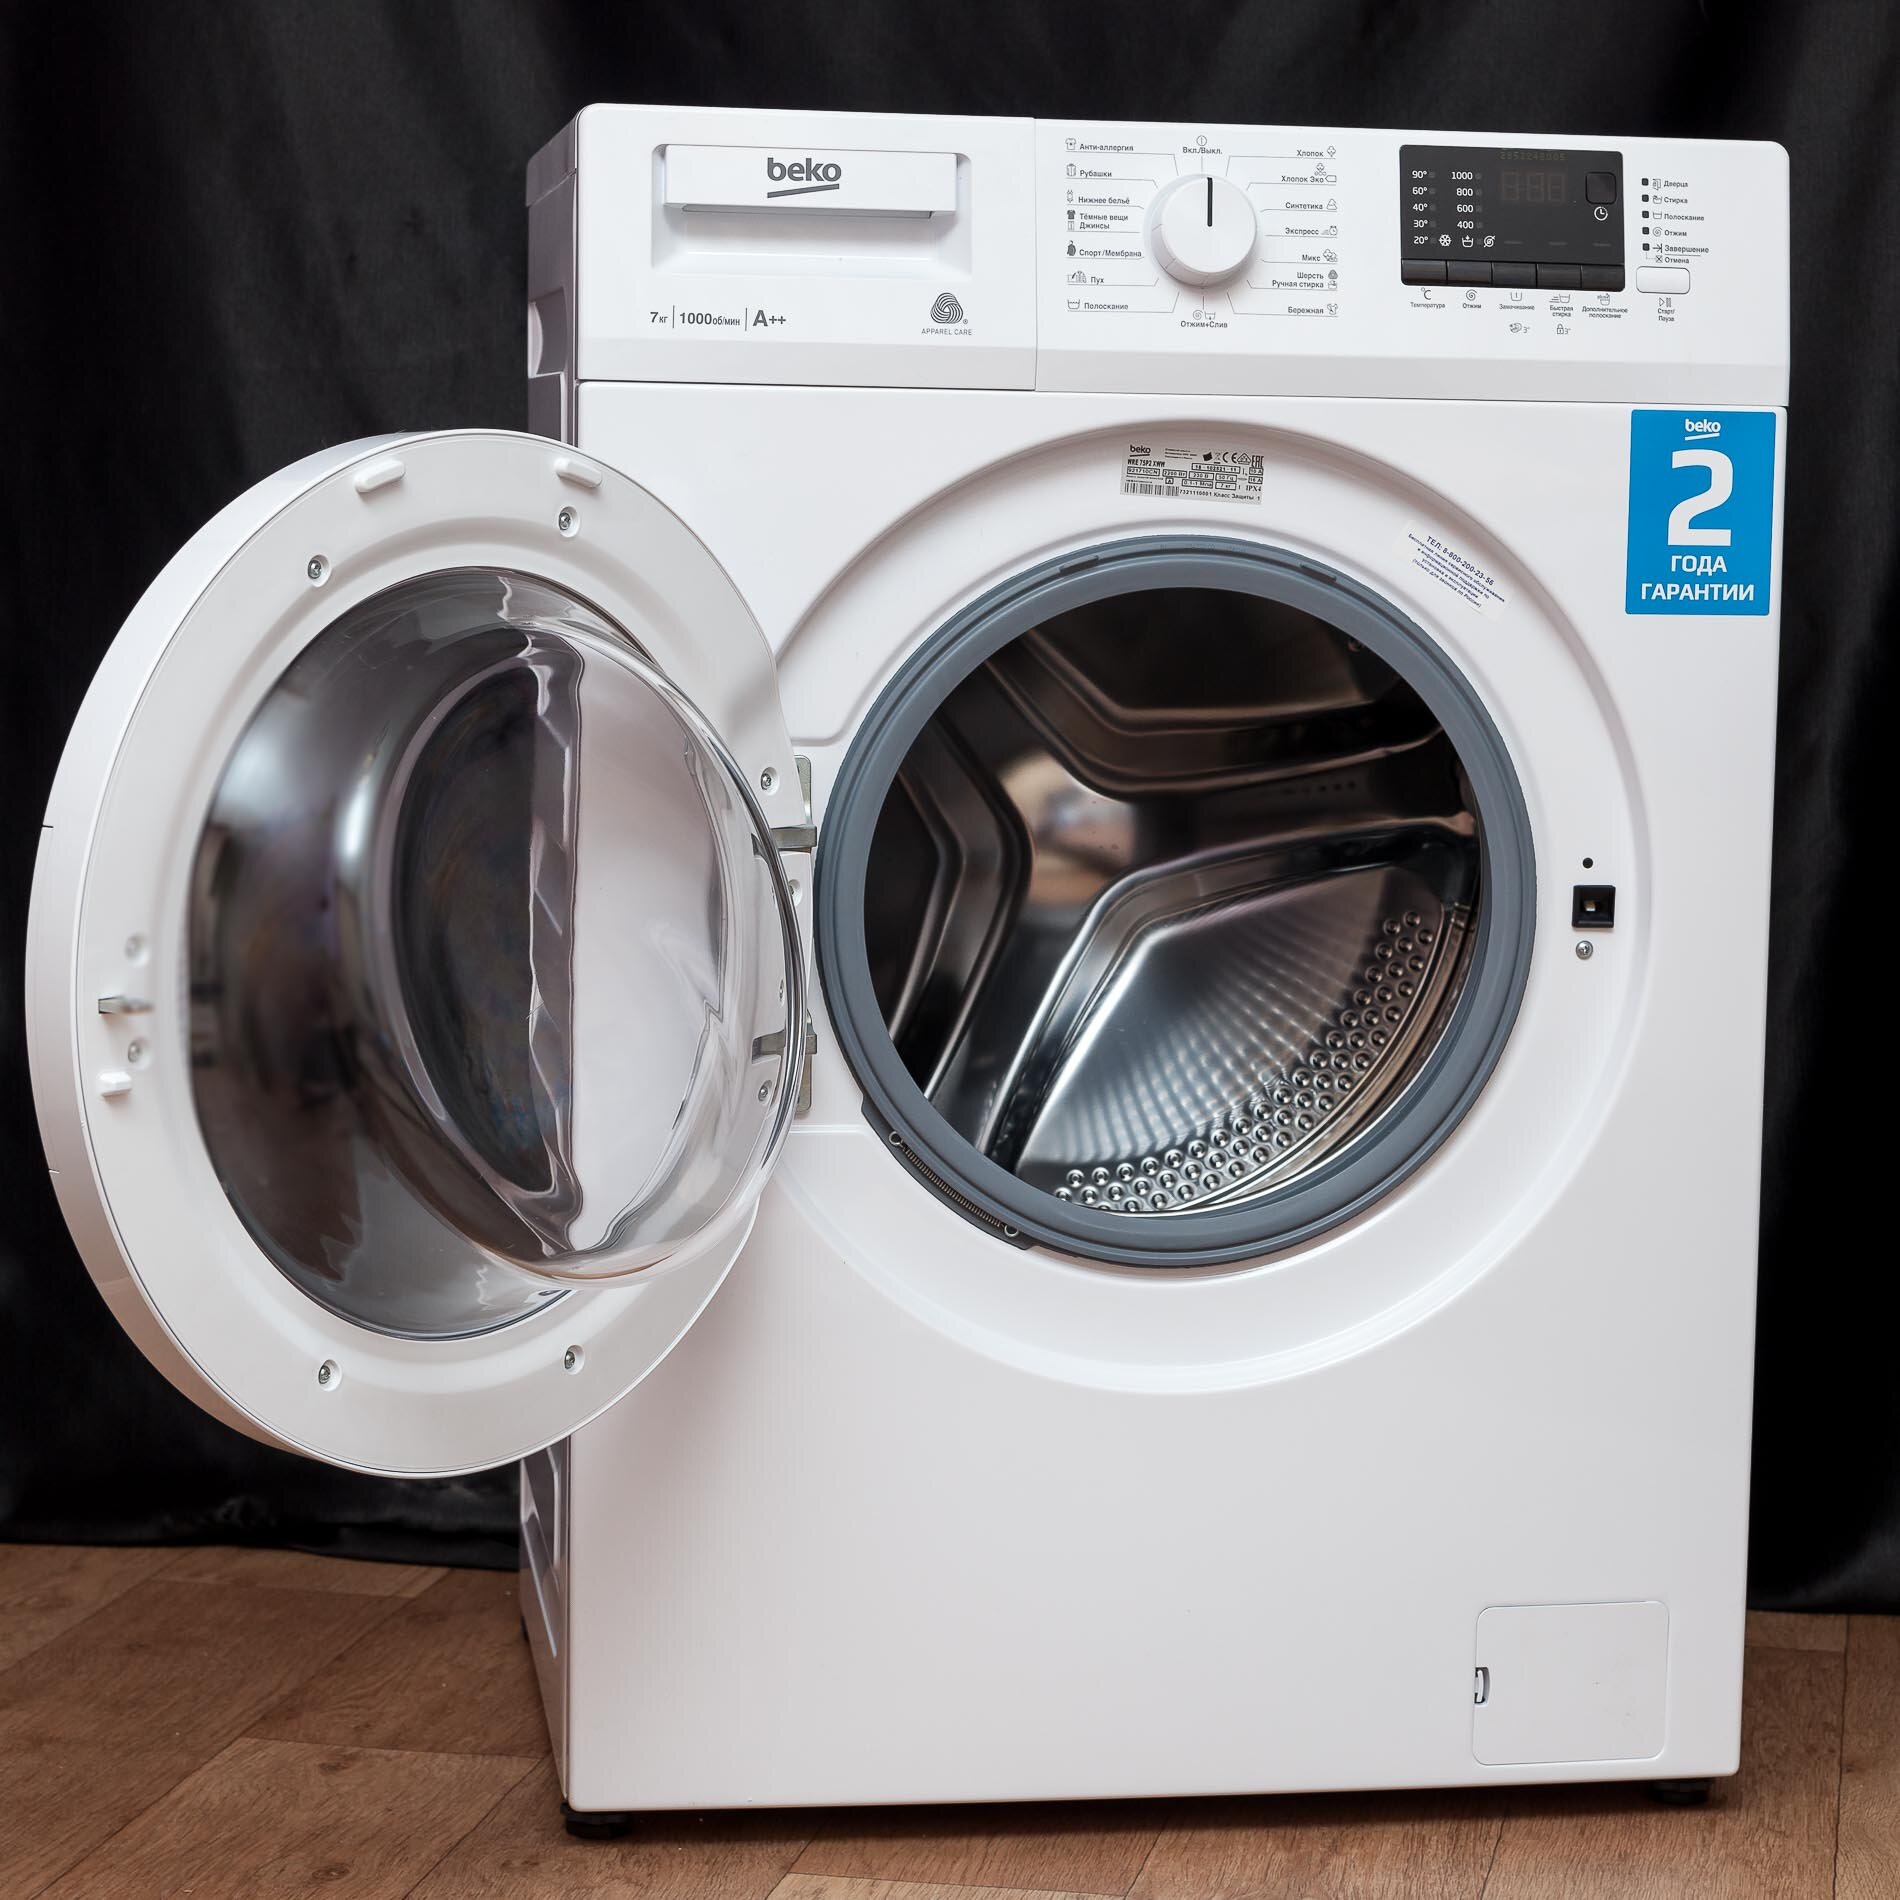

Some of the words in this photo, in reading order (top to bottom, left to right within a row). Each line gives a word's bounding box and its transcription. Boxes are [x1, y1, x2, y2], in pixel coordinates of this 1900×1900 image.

[1079, 144, 1134, 152] Анти-аллергия
[1182, 146, 1223, 155] Вкл./Выкл.
[1296, 150, 1324, 158] Хлопок
[767, 157, 842, 182] beko
[1079, 169, 1112, 178] Рубашки
[1412, 170, 1427, 179] 90°
[1451, 171, 1473, 180] 1000
[1281, 175, 1308, 183] Хлопок
[1664, 180, 1689, 188] Дверца
[1412, 187, 1428, 195] 60°
[1456, 188, 1473, 196] 800
[1078, 196, 1107, 204] Нижнее
[1108, 196, 1130, 204] бельё
[1664, 196, 1688, 204] Стирка
[1285, 202, 1323, 210] Синтетика
[1412, 203, 1428, 212] 40°
[1456, 204, 1474, 213] 600
[1079, 212, 1108, 220] Тёмные
[1664, 213, 1705, 221] Полоскание
[1079, 222, 1110, 230] Джинсы
[1413, 220, 1428, 228] 30°
[1457, 221, 1474, 229] 400
[1285, 227, 1319, 235] Экспресс
[1664, 229, 1687, 237] Отжим
[1413, 236, 1429, 244] 20°
[1664, 244, 1709, 253] Завершение
[1301, 254, 1321, 262] Микс
[1664, 256, 1690, 264] Отмена
[1296, 271, 1324, 279] Шерсть
[1090, 276, 1104, 285] Пух
[1272, 280, 1297, 288] Ручная
[1299, 281, 1324, 289] стирка
[1084, 302, 1129, 310] Полоскание
[1582, 306, 1628, 314] Дополнительное
[1287, 306, 1324, 315] Бережная
[753, 309, 786, 327] A++
[1658, 315, 1675, 323] Пауза
[1180, 320, 1228, 329] Отжим+Слив
[921, 328, 952, 336] APPAREL
[953, 328, 972, 336] CARE
[1685, 419, 1721, 433] beko
[1130, 444, 1151, 454] beko
[1667, 449, 1734, 546] 2
[1426, 536, 1442, 550] ТЕЛ:
[1671, 555, 1727, 576] ГОДА
[1641, 583, 1754, 601] ГАРАНТИИ
